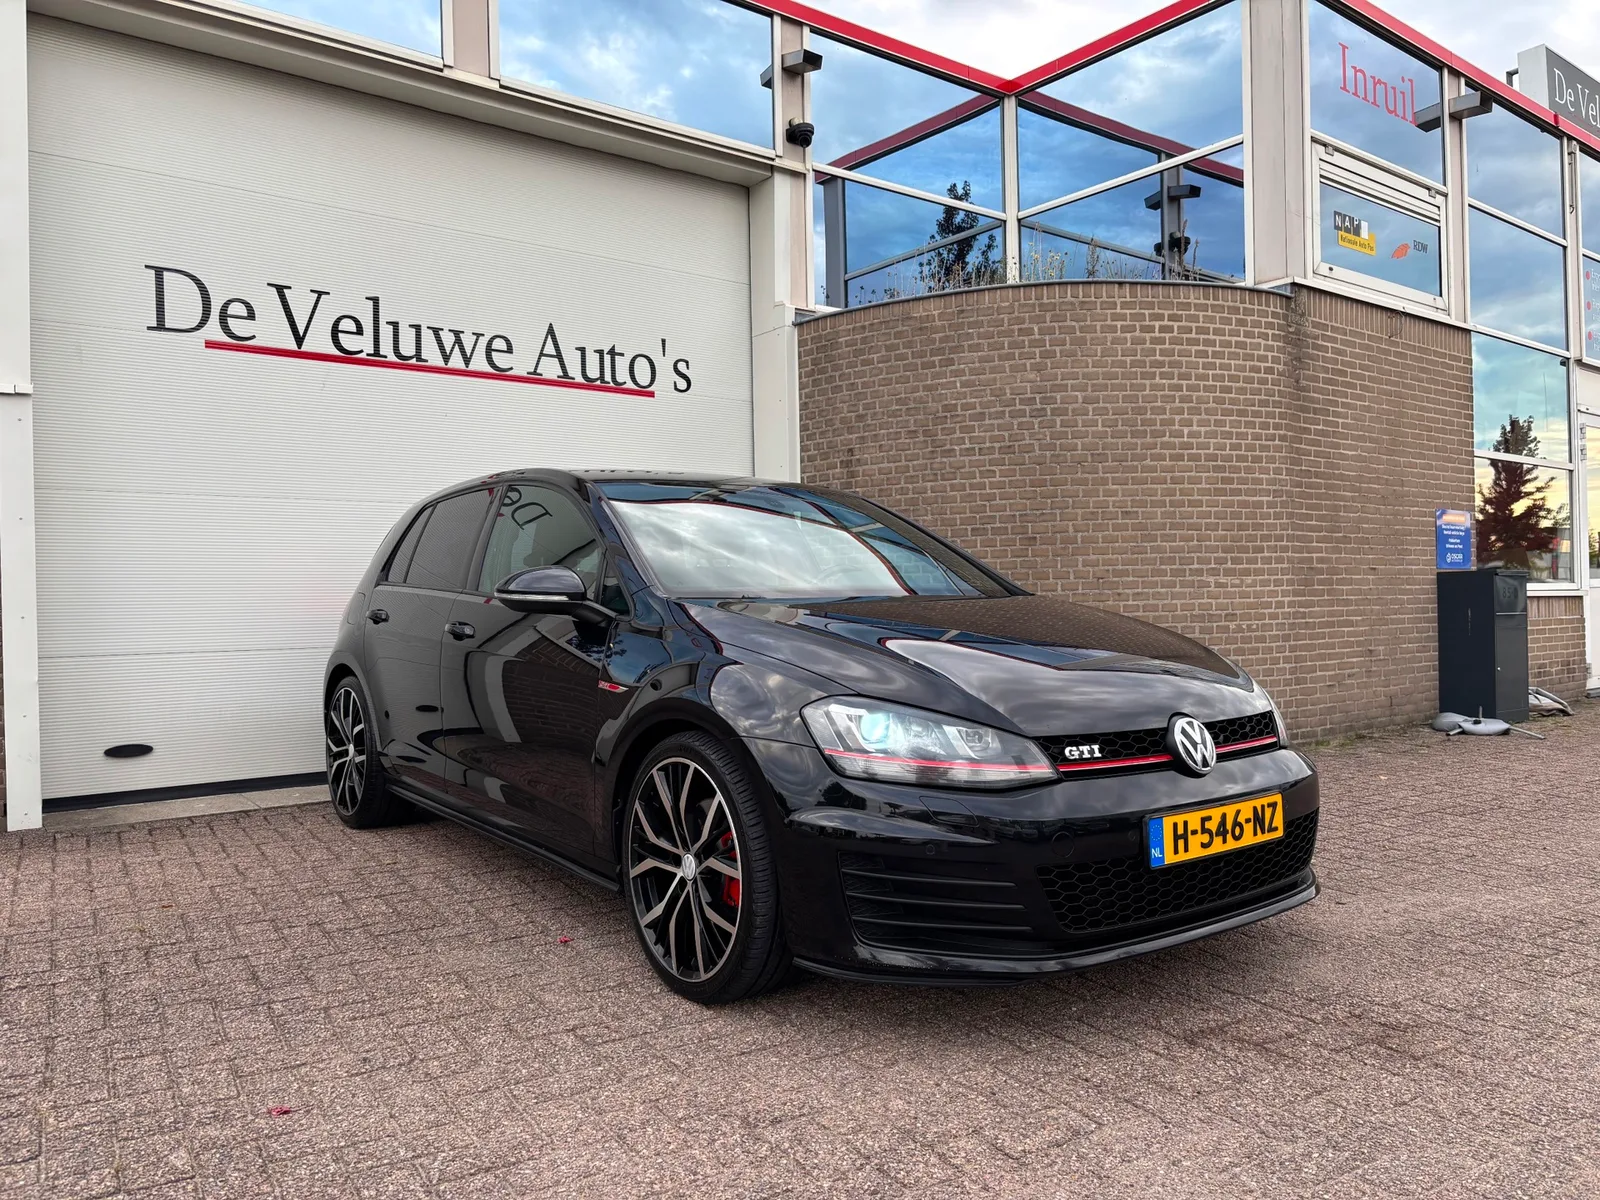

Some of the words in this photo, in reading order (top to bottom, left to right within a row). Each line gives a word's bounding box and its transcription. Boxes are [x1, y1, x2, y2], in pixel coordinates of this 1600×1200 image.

[1338, 42, 1418, 126] Inruil
[1553, 67, 1575, 112] De
[1336, 215, 1359, 228] NAP
[1413, 239, 1429, 254] RDW
[143, 263, 258, 342] De
[266, 282, 515, 373] Veluwe
[526, 321, 693, 394] Auto's
[1064, 744, 1103, 760] GTI
[1172, 800, 1280, 856] H-546-NZ
[1151, 847, 1163, 859] NL
